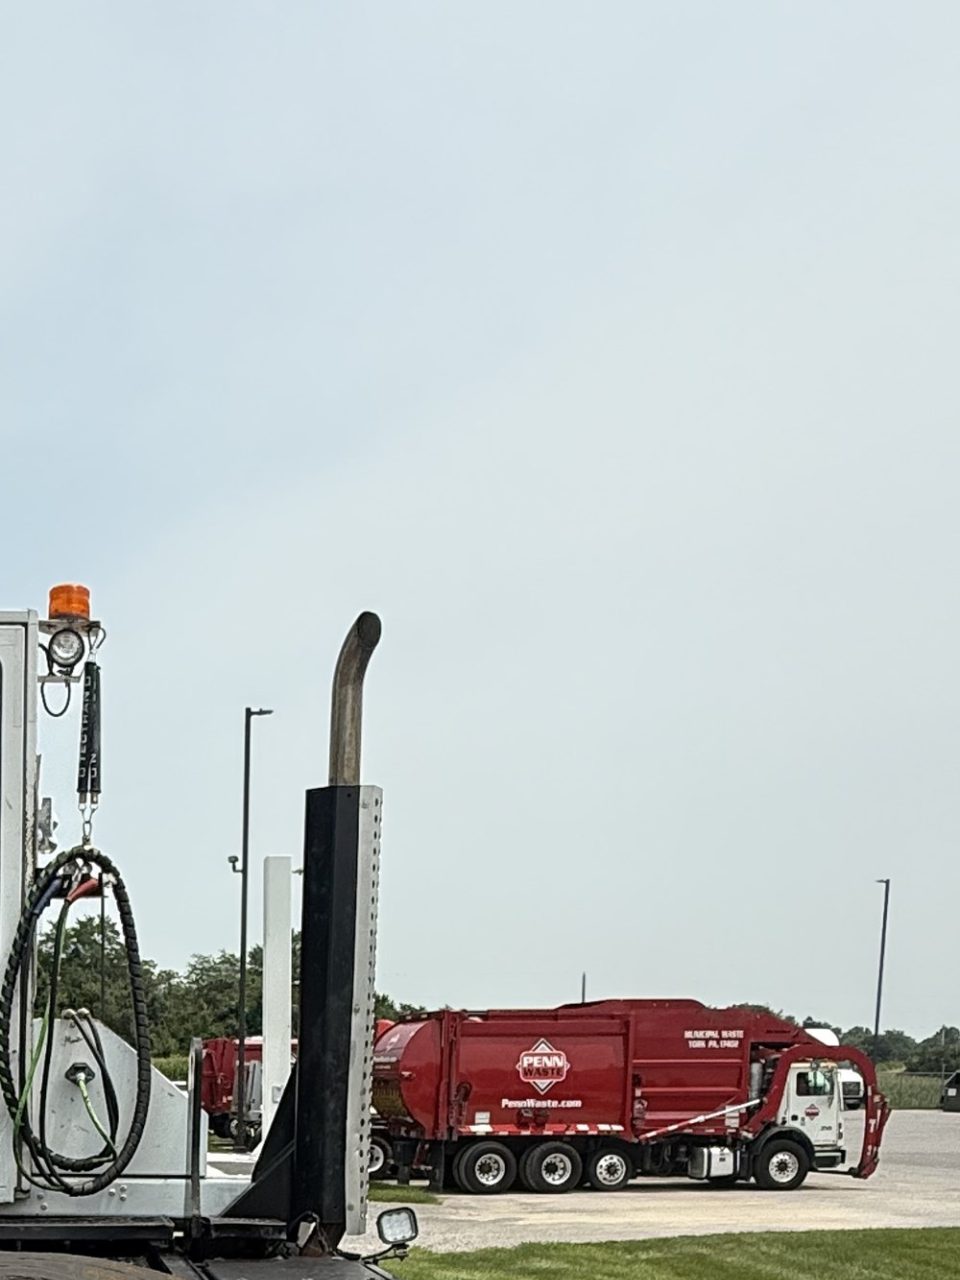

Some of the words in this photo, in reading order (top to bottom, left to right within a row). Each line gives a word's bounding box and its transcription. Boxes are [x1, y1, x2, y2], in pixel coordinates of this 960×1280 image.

[522, 1056, 564, 1067] PENN
[523, 1067, 563, 1077] WASTE
[501, 1098, 582, 1108] PennWaste.com
